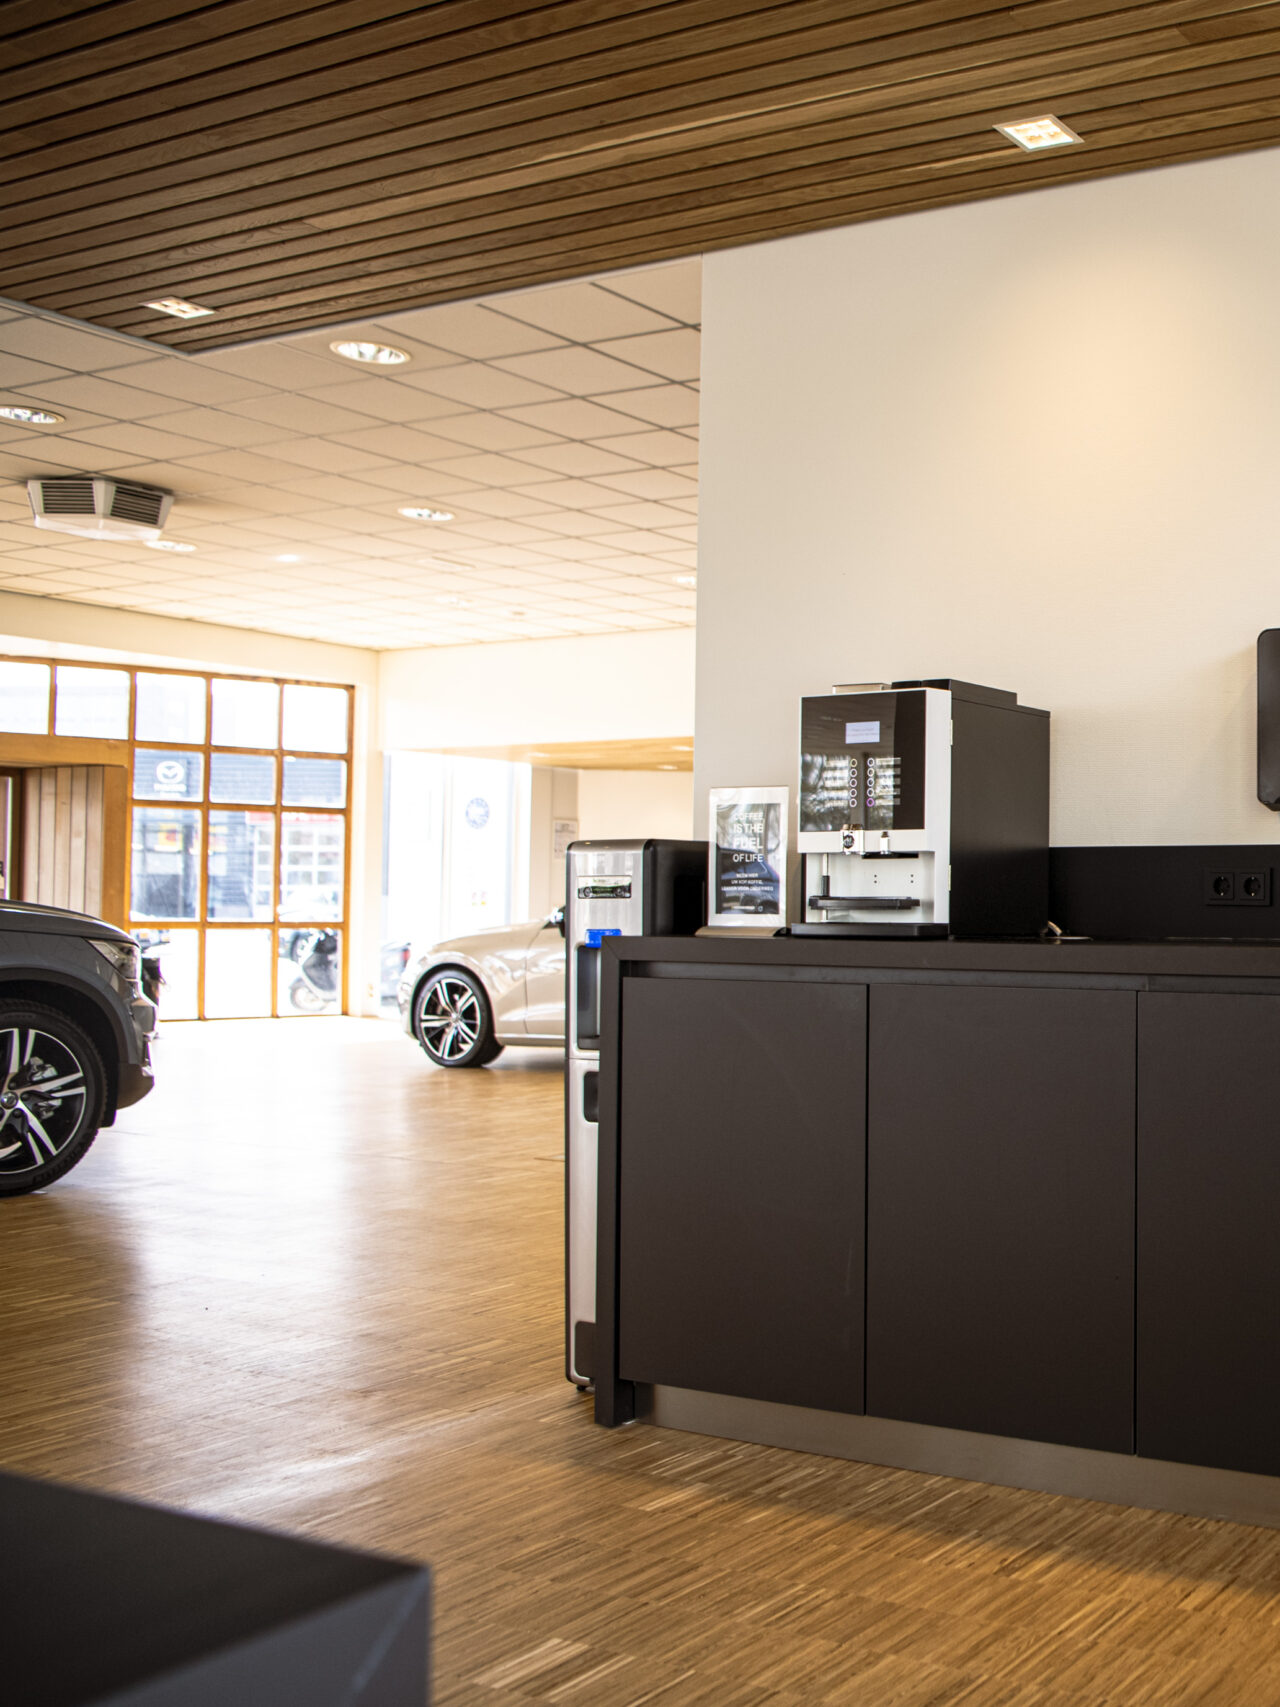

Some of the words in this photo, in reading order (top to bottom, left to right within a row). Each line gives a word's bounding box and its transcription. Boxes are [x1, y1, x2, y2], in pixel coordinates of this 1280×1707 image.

[733, 823, 743, 833] IS
[744, 823, 764, 833] THE
[733, 837, 764, 849] FUEL
[732, 853, 744, 863] OF
[745, 853, 764, 863] LIFE
